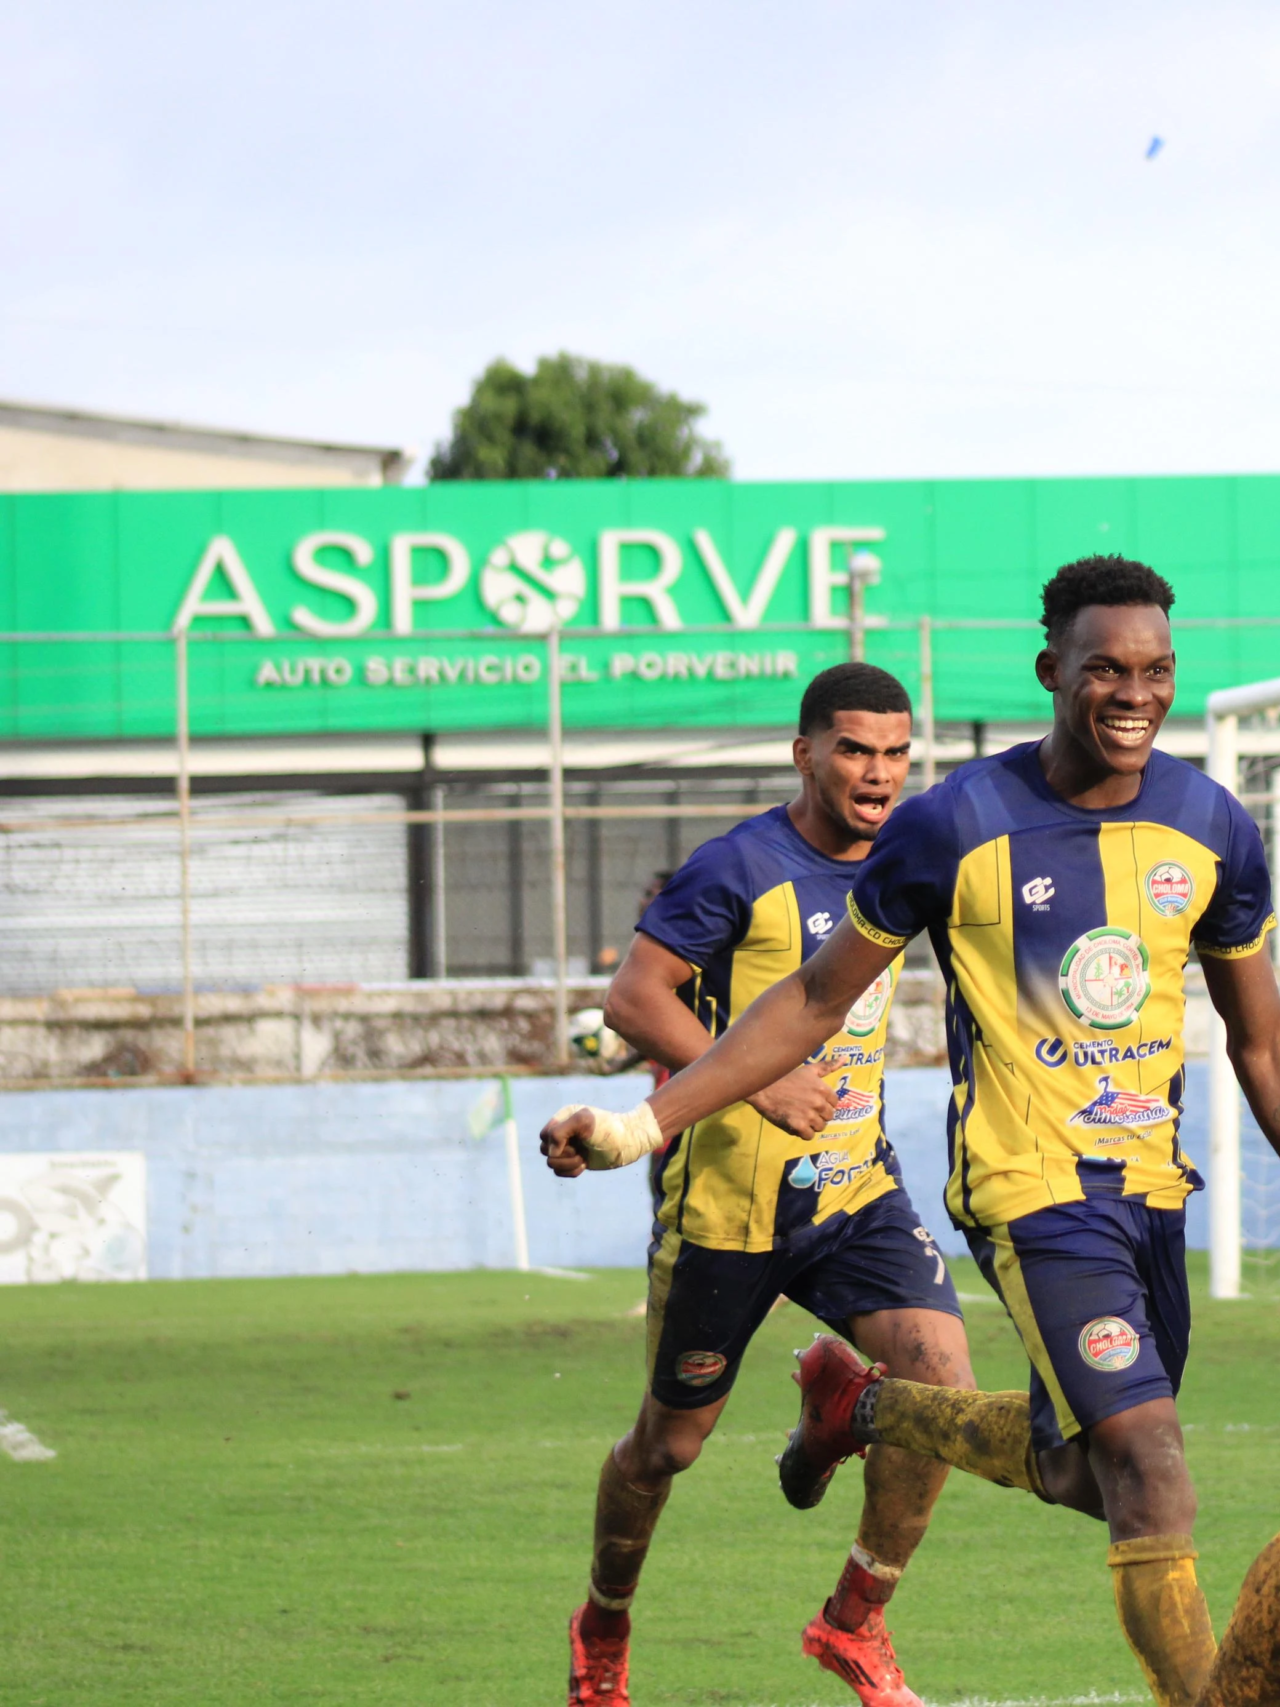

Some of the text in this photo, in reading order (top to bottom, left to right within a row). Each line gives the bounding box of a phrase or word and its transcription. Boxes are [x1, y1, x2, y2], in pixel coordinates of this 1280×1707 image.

[171, 526, 889, 638] ASPORVE
[257, 651, 798, 686] AUTO SERVICIO EL PORVENIR
[1152, 883, 1190, 894] CHOLOMA
[1032, 904, 1051, 912] SPORTS
[1073, 1039, 1114, 1050] CEMENTO
[1074, 1036, 1173, 1067] ULTRACEM
[924, 1246, 945, 1285] 7
